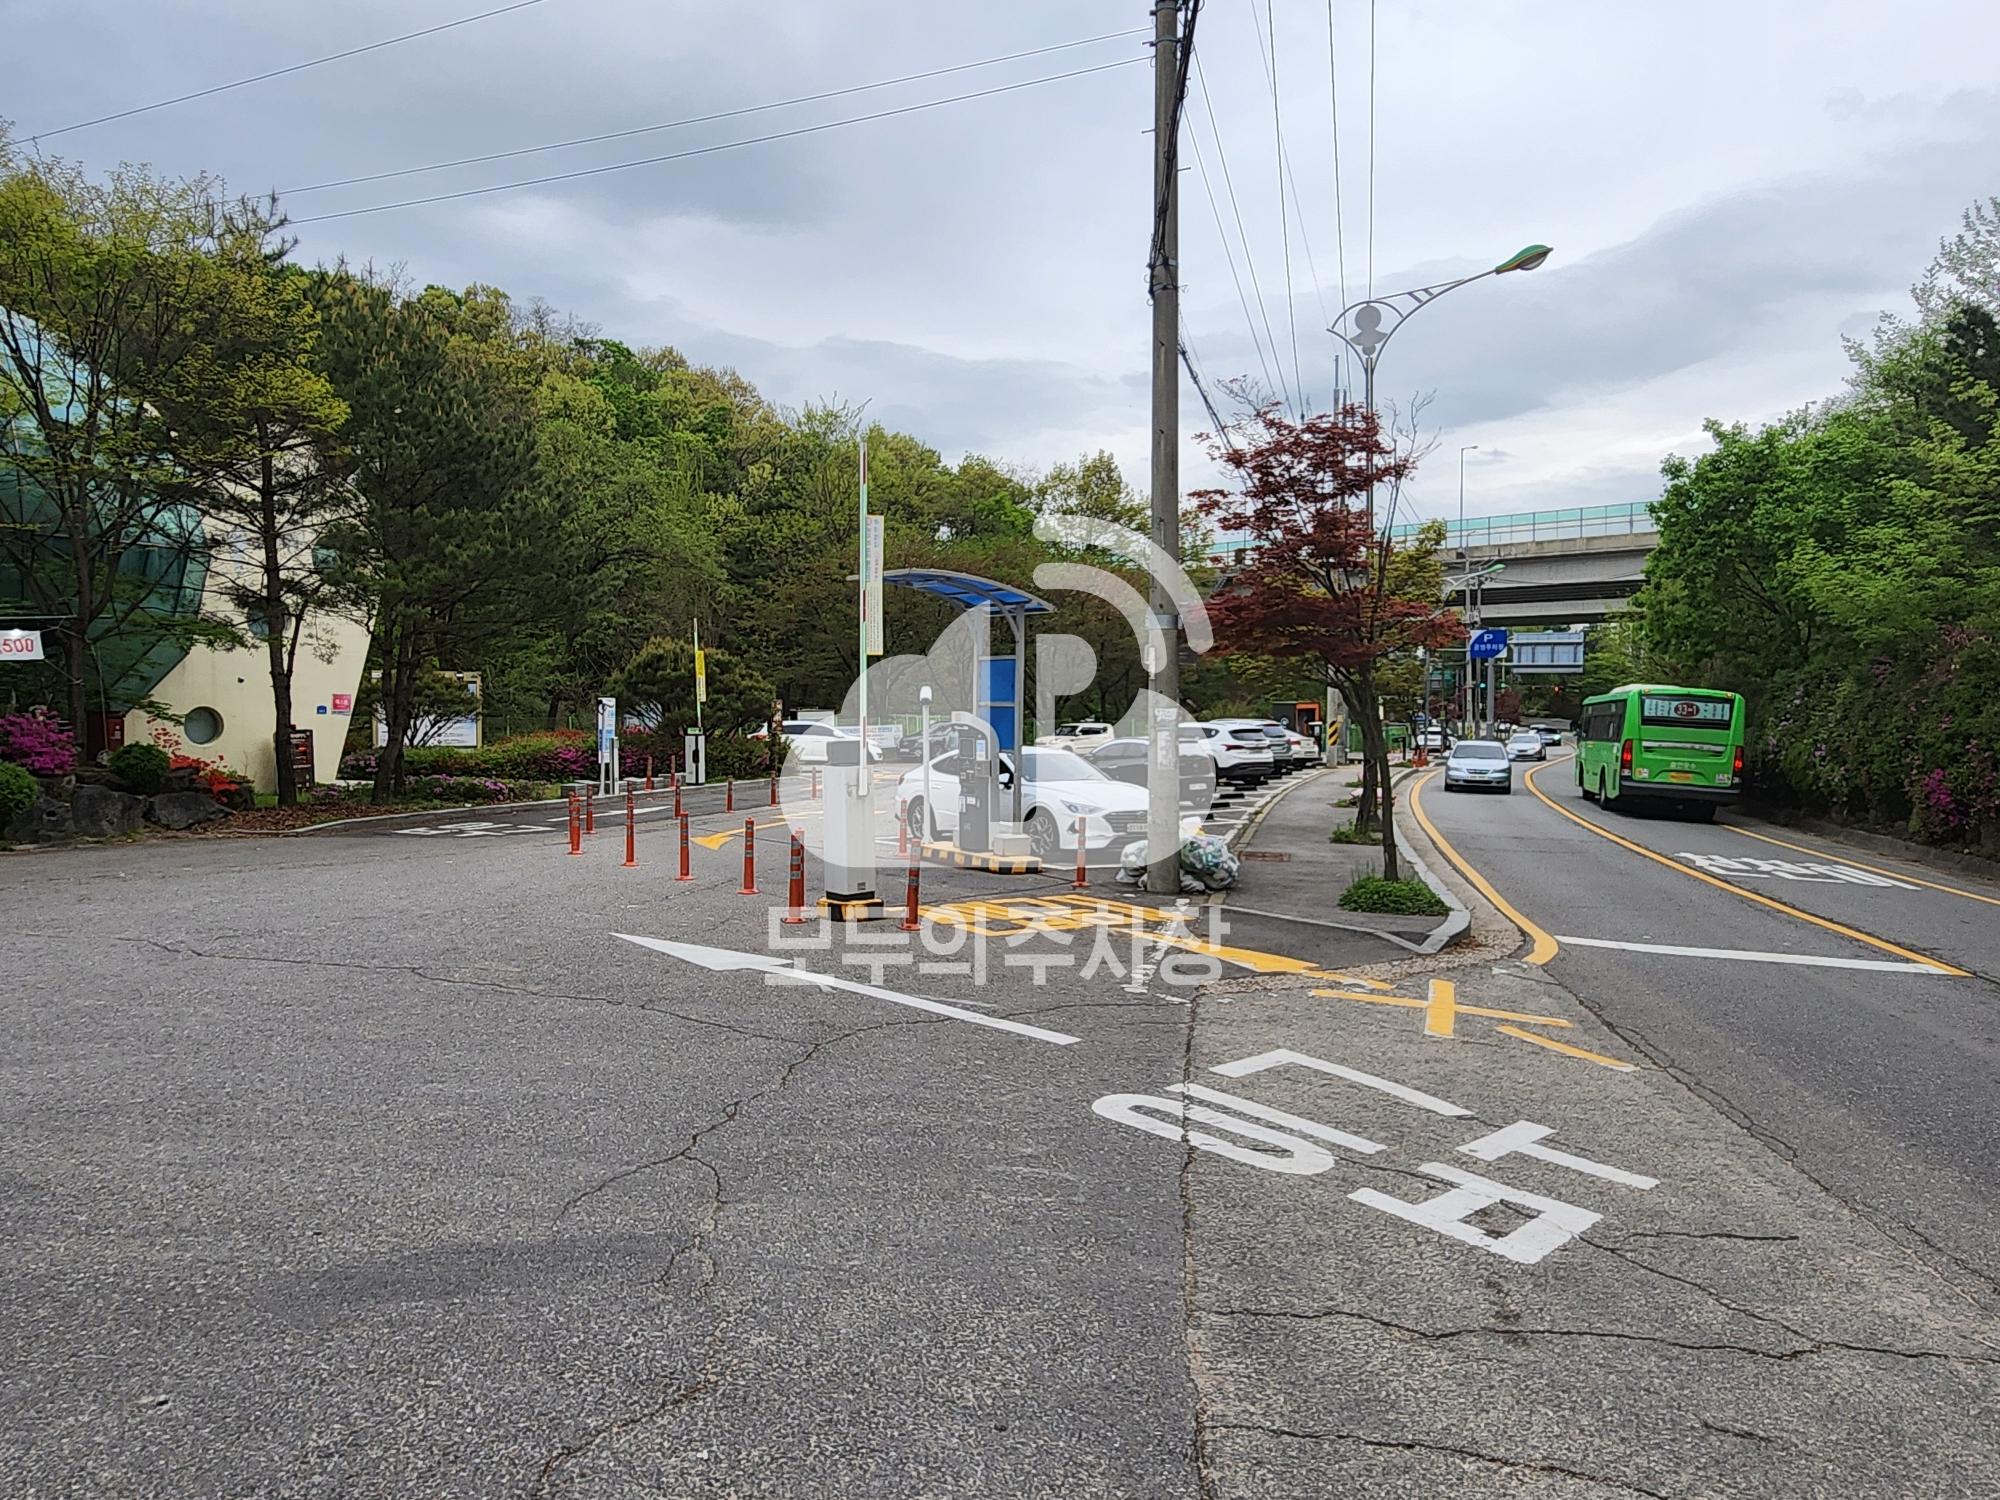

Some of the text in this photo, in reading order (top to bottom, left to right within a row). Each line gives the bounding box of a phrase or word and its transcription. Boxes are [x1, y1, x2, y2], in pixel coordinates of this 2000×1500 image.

[1484, 634, 1494, 642] P
[1677, 704, 1697, 715] 33-1
[1673, 852, 1922, 891] 천천히
[1092, 1048, 1661, 1264] 입구
